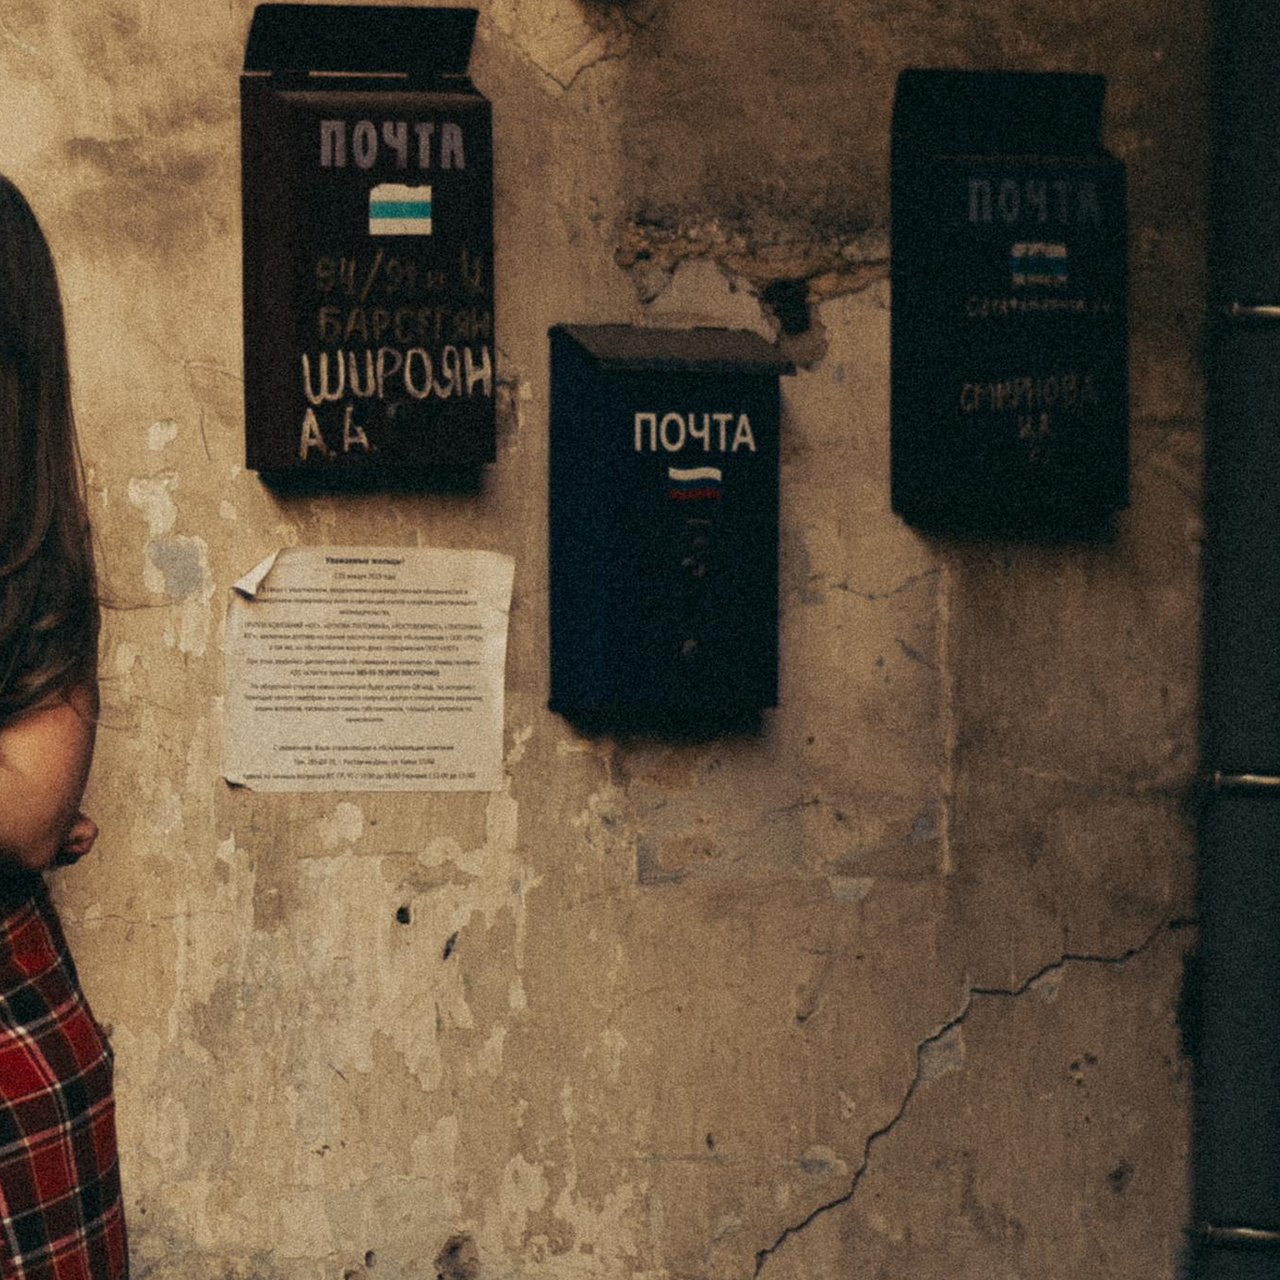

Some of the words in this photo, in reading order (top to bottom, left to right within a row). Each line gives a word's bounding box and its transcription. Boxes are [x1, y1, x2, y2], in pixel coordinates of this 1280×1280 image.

[319, 118, 467, 171] ПОЧТА
[968, 178, 1102, 225] ПОЧТА
[632, 410, 758, 454] ПОЧТА
